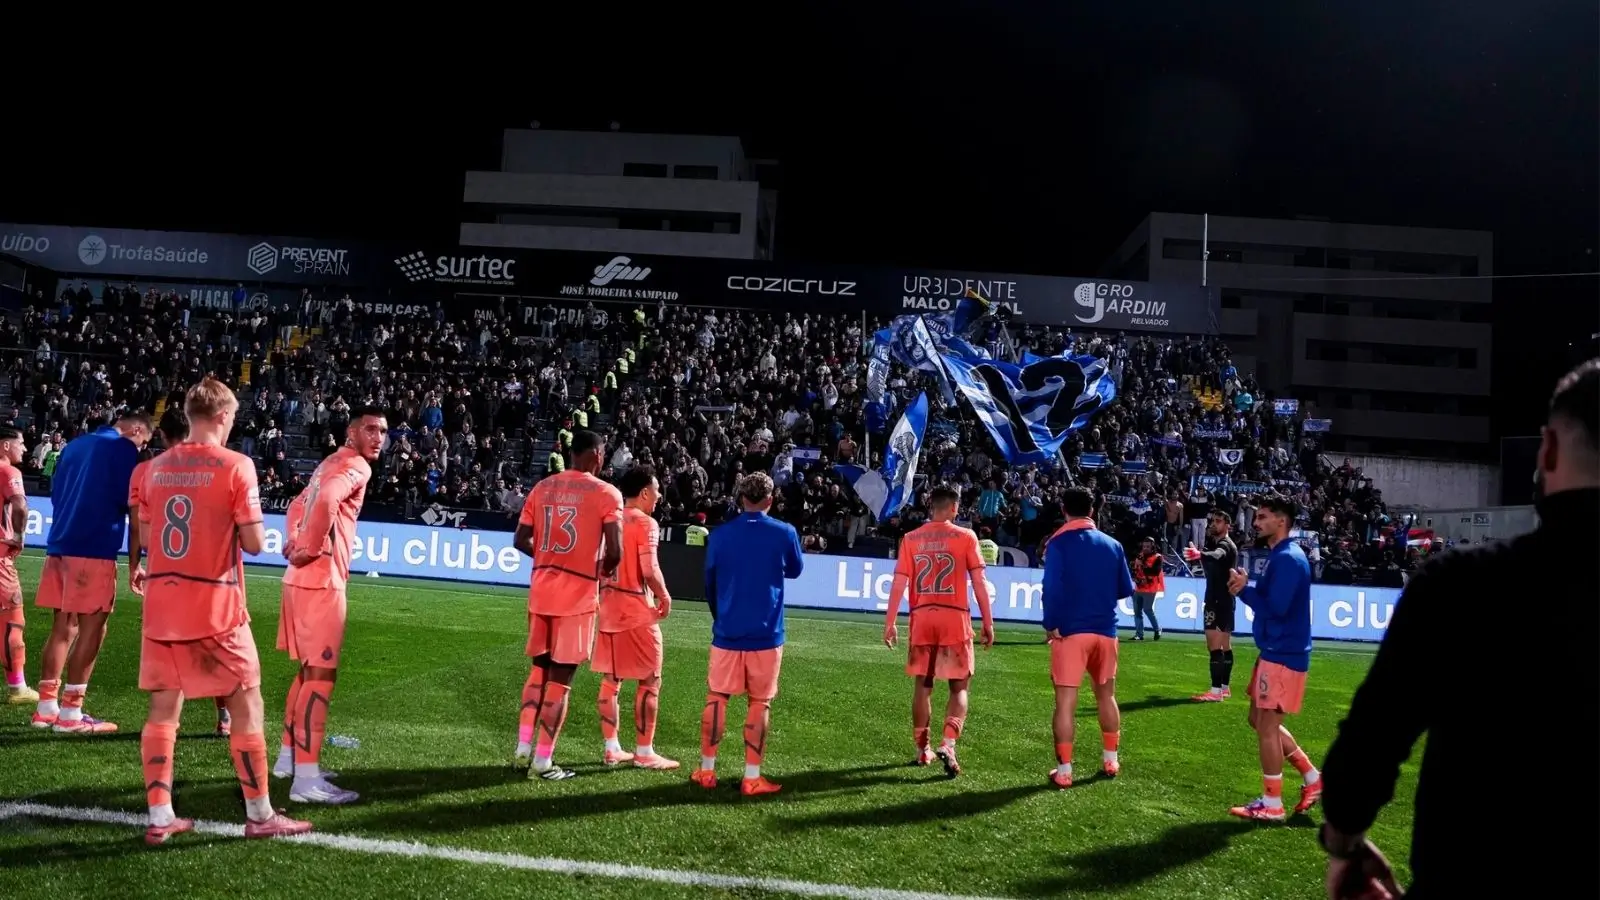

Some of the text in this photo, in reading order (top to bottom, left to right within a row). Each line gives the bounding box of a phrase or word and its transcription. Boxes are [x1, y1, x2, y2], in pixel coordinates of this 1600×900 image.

[109, 244, 208, 264] TrofaSaúde
[281, 247, 348, 263] PREVENT
[294, 260, 350, 276] SPRAIN
[435, 254, 516, 280] surtec
[560, 284, 679, 301] JOSÉ MOREIRA SAMPAIO
[374, 302, 394, 314] EM
[903, 296, 951, 311] MALO
[1130, 317, 1169, 327] RELVADOS
[161, 494, 193, 560] 8
[540, 504, 577, 554] 13
[403, 530, 520, 573] clube
[913, 552, 956, 595] 22
[1328, 591, 1390, 629] clu
